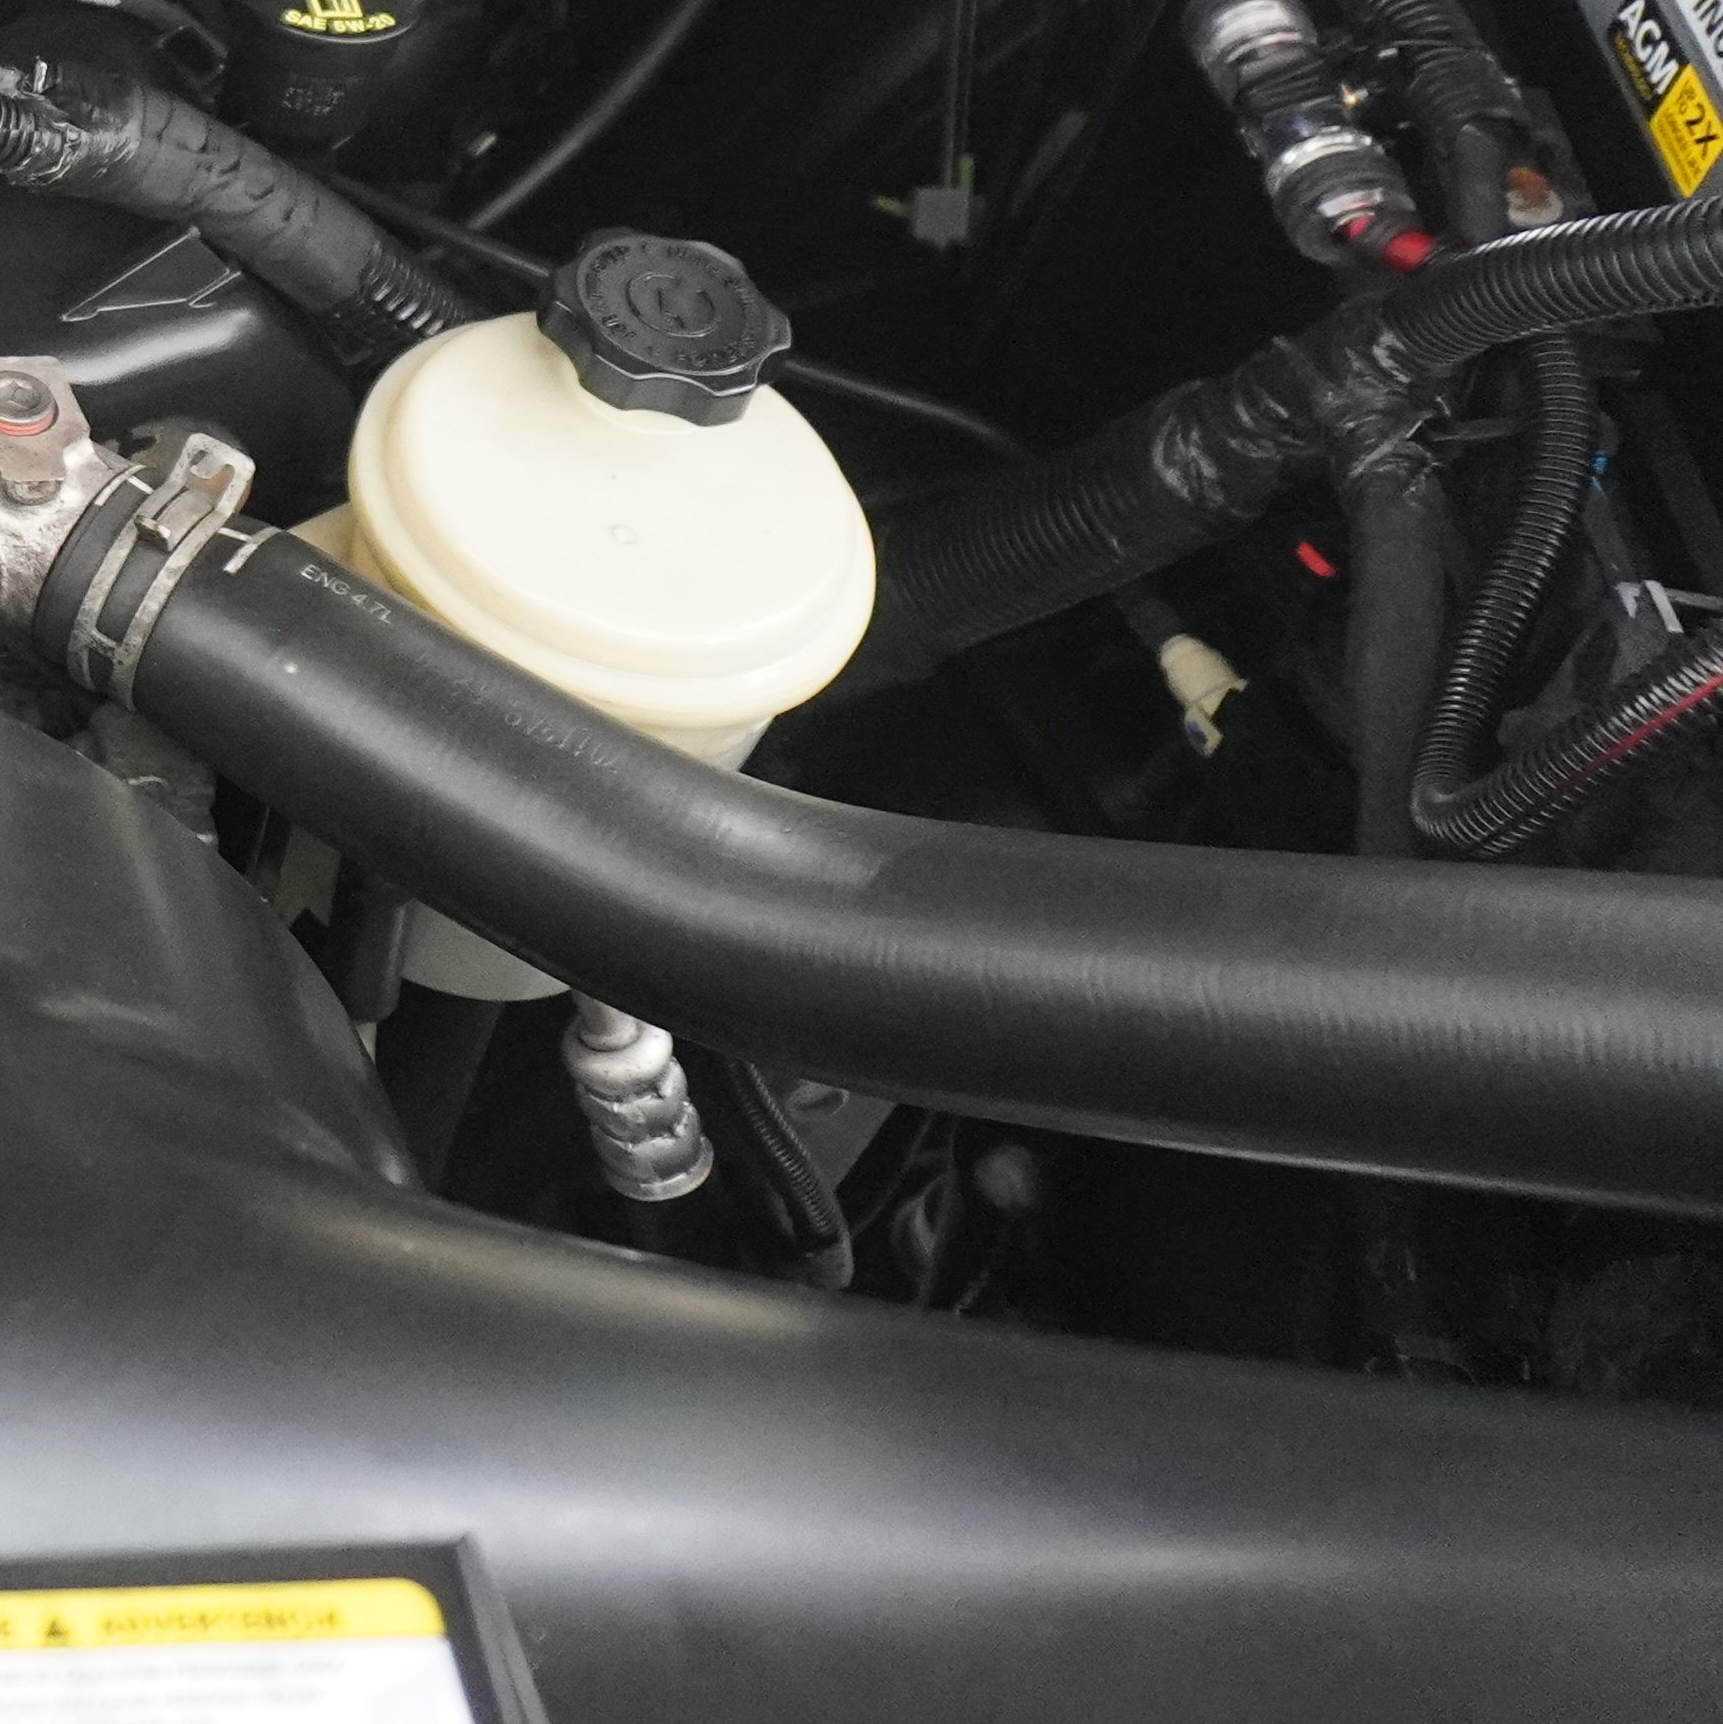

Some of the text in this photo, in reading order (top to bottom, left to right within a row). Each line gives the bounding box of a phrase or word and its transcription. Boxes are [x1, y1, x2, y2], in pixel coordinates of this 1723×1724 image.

[281, 8, 397, 34] SAE 5W-20
[1685, 101, 1719, 161] 2X
[300, 563, 351, 596] ENG
